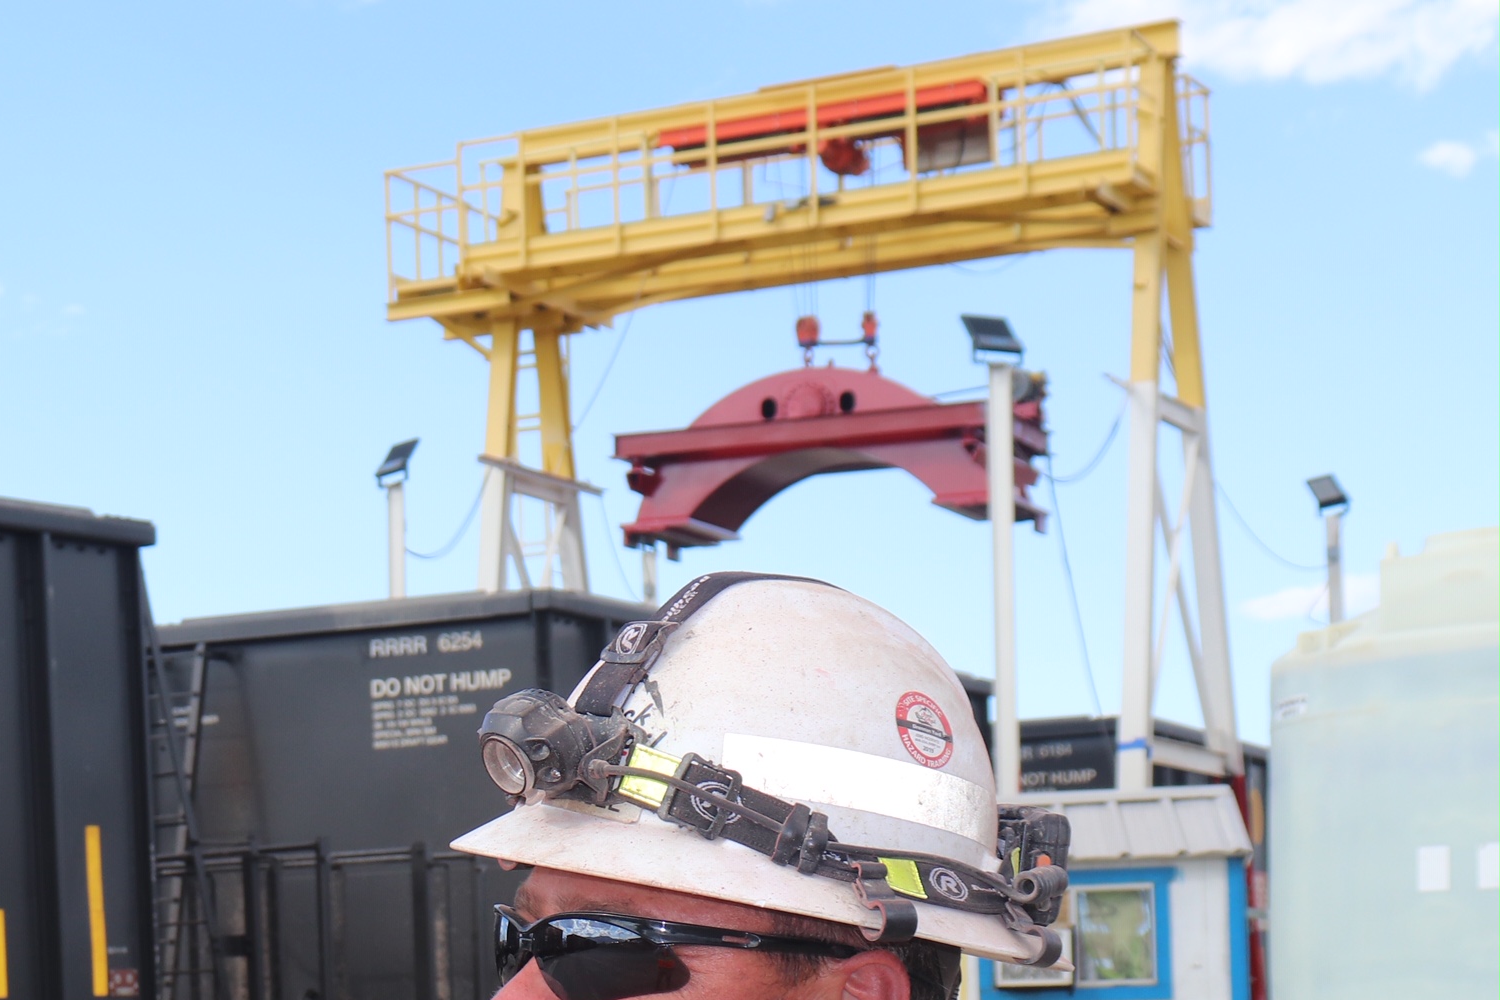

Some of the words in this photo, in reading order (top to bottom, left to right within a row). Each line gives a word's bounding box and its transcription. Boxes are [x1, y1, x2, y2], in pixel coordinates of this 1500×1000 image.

[369, 635, 427, 658] RRRR
[437, 630, 483, 653] 6254
[370, 677, 401, 699] DO
[404, 673, 447, 695] NOT
[450, 668, 512, 692] HUMP
[902, 733, 927, 765] HAZARD
[927, 748, 951, 768] TRAINING
[1051, 768, 1097, 786] HUMP
